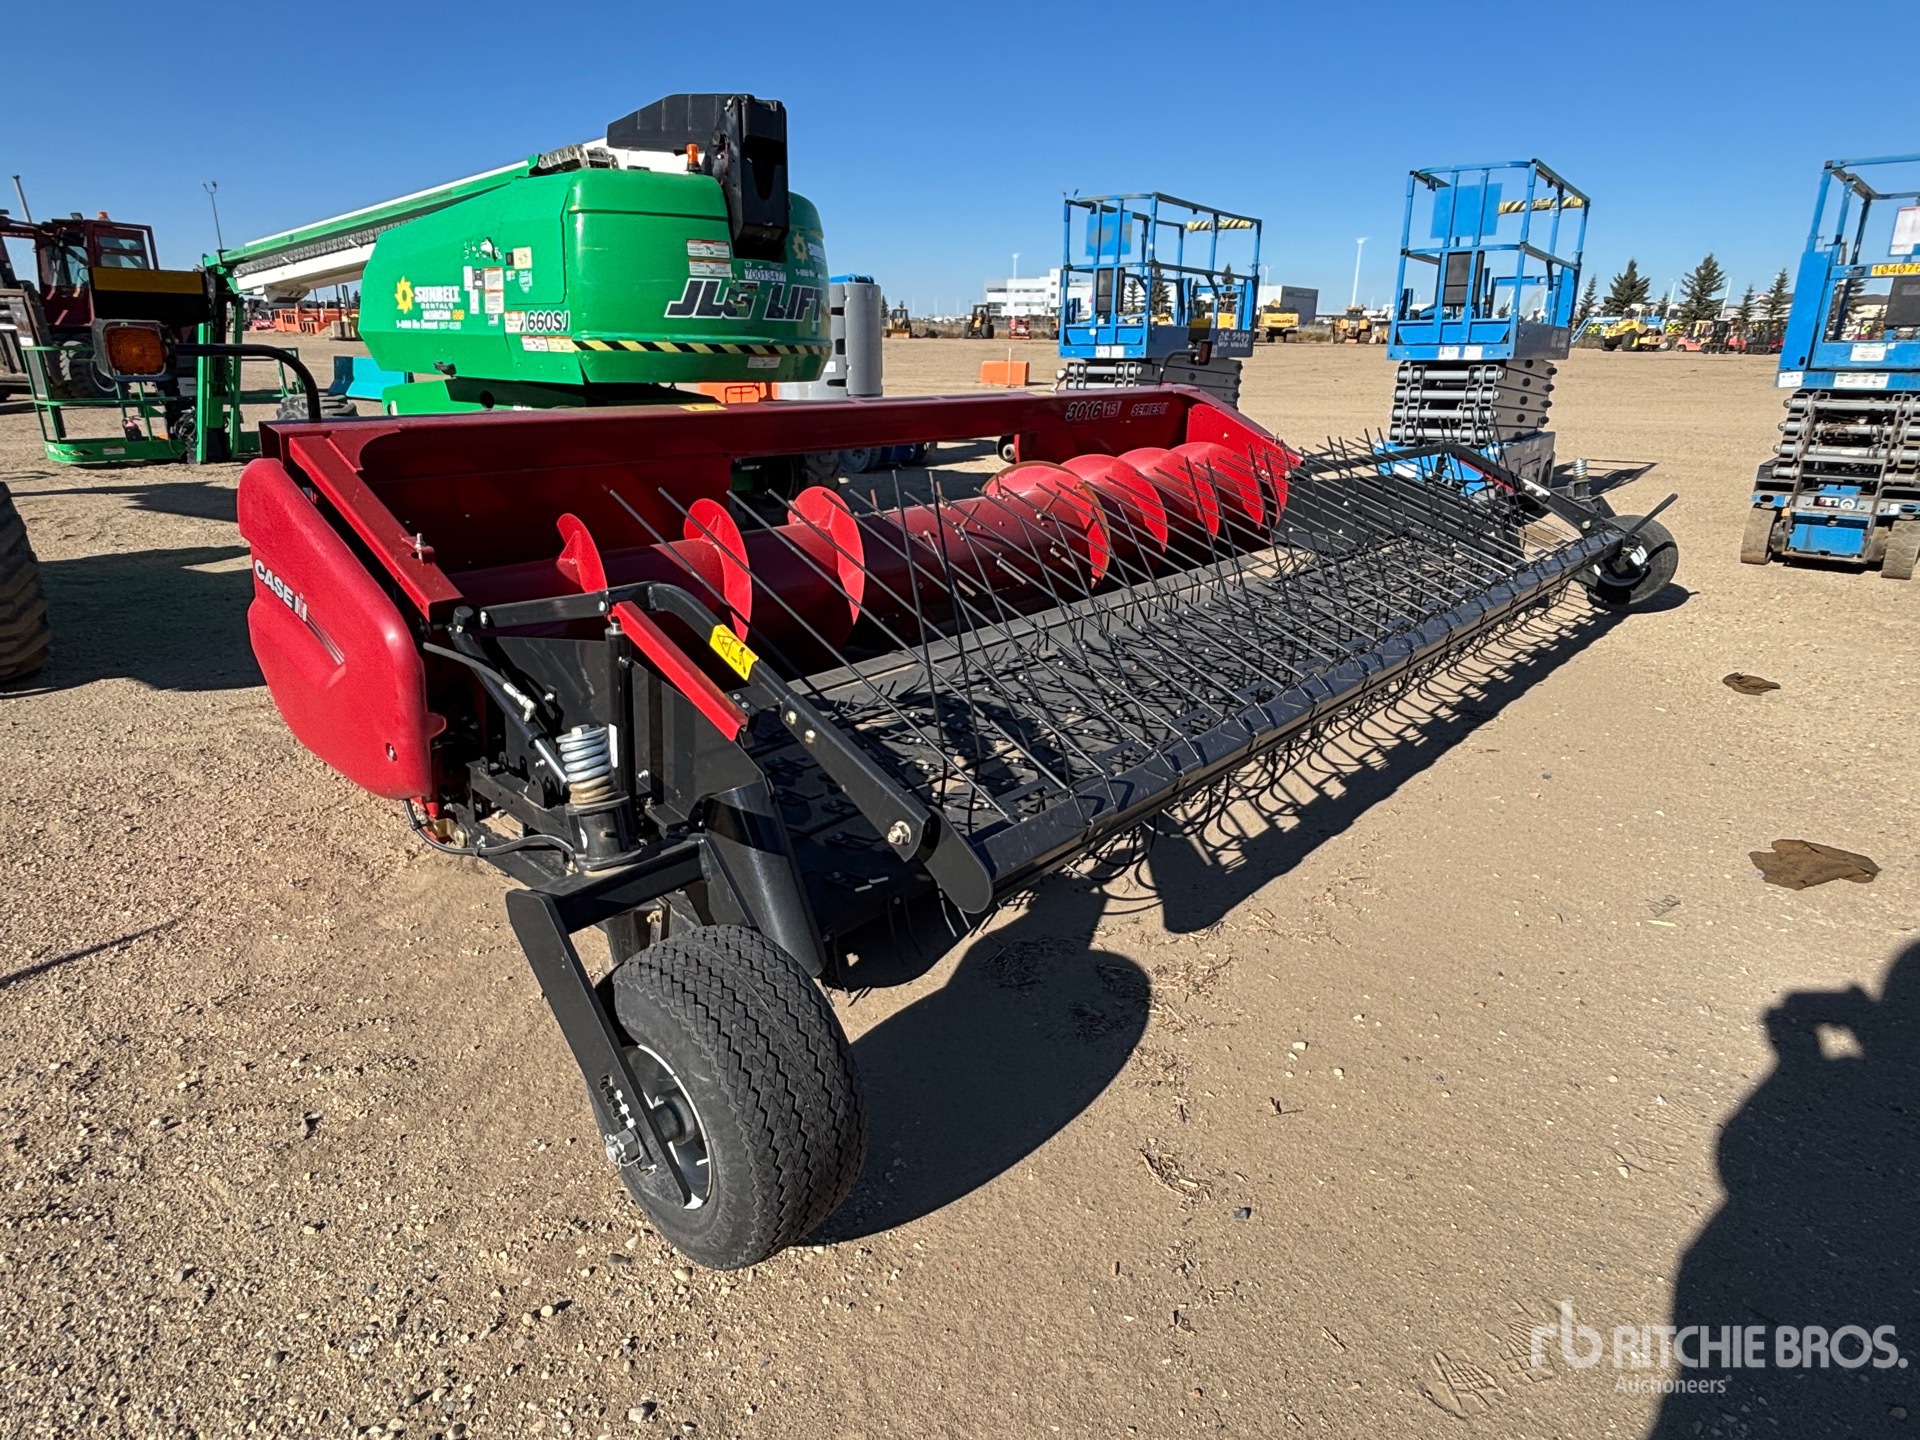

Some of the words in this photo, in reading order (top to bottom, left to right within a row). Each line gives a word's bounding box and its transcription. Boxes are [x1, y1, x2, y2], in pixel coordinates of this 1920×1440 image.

[414, 285, 461, 303] SUNBELT
[763, 282, 824, 322] LIFT
[527, 310, 570, 332] 660SJ
[1065, 400, 1103, 421] 3016
[254, 559, 294, 610] CASE
